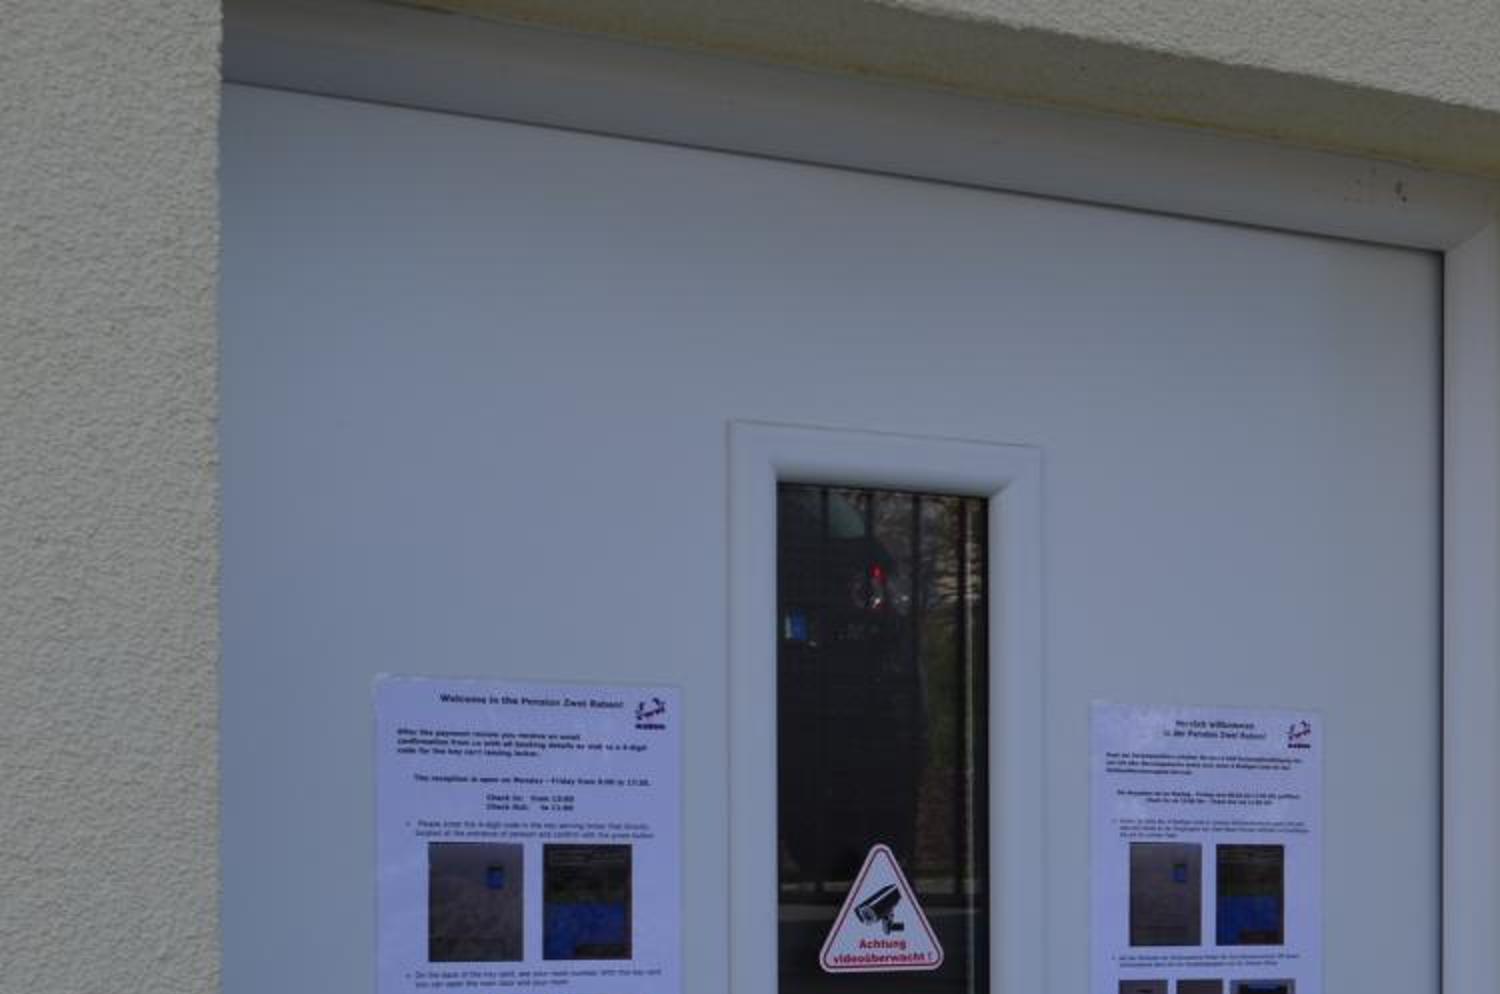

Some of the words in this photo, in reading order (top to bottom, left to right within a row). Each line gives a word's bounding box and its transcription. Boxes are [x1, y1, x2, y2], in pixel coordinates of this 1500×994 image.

[440, 693, 487, 704] Welcome
[502, 695, 519, 705] the
[859, 938, 907, 951] Achtung
[833, 952, 926, 965] videoüberwacht
